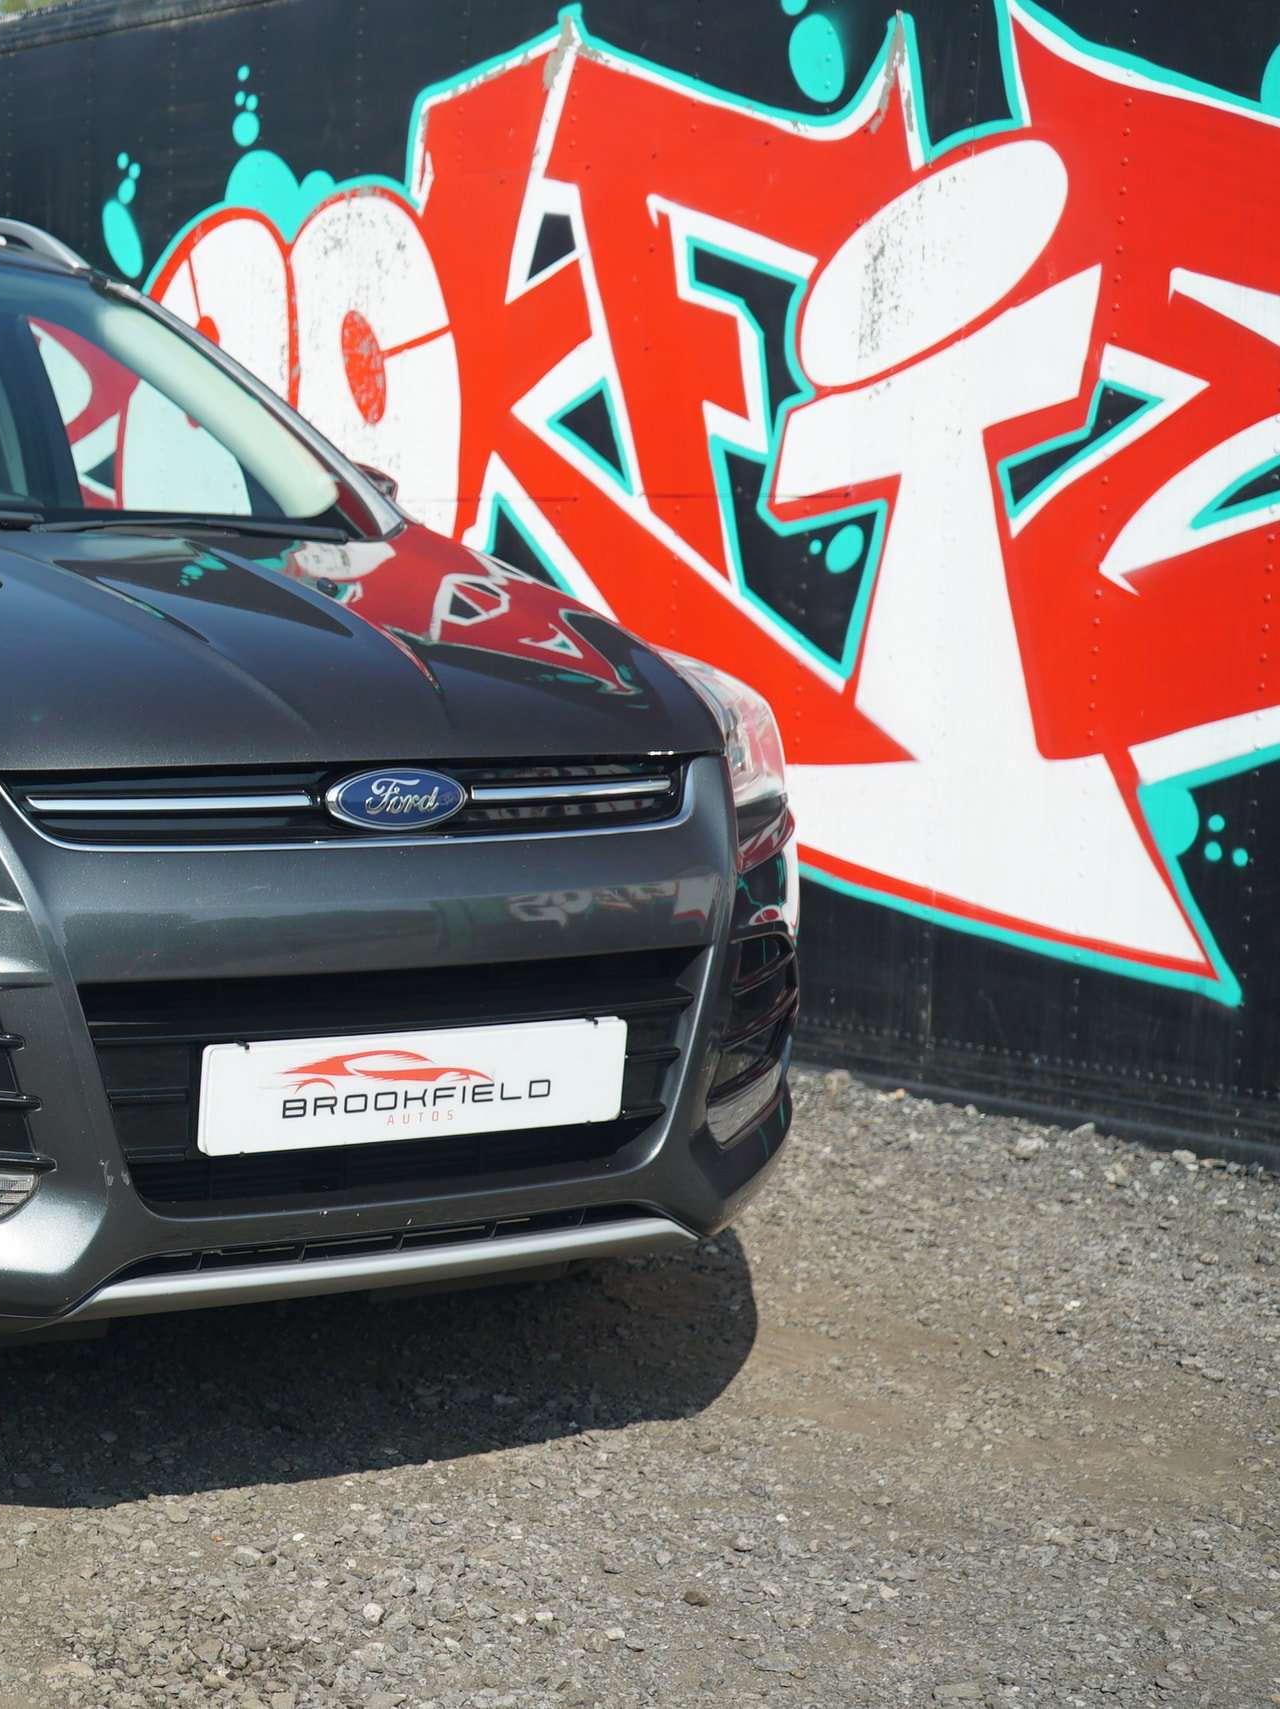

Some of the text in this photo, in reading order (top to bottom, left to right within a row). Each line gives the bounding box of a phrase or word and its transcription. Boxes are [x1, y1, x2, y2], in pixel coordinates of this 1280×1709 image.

[365, 777, 440, 815] Ford
[281, 1079, 552, 1119] BROOKFIELD
[386, 1109, 455, 1127] AUTOS
